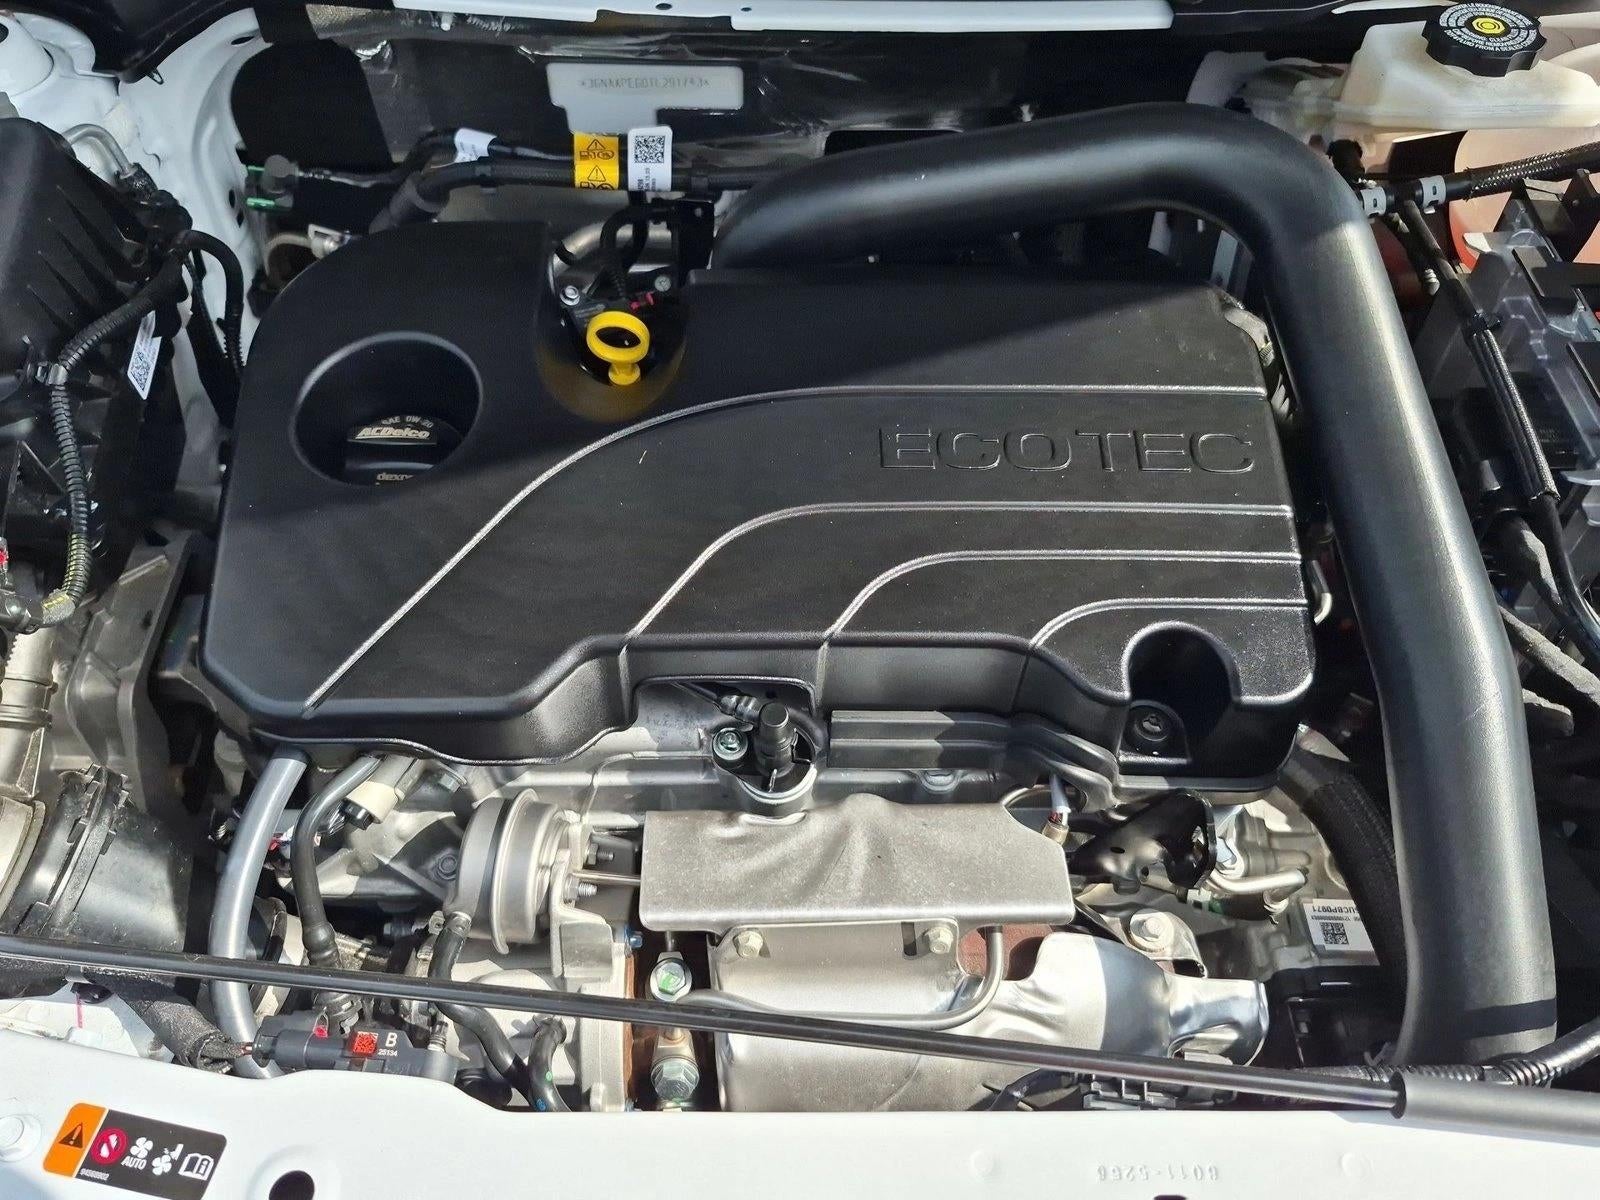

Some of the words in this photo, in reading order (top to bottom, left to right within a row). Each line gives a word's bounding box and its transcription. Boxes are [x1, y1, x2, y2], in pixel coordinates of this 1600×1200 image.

[381, 416, 400, 424] SAE
[355, 426, 431, 440] ACDelco
[879, 427, 1255, 475] ECOTEC
[385, 1032, 398, 1047] B
[121, 1155, 148, 1171] AUTO
